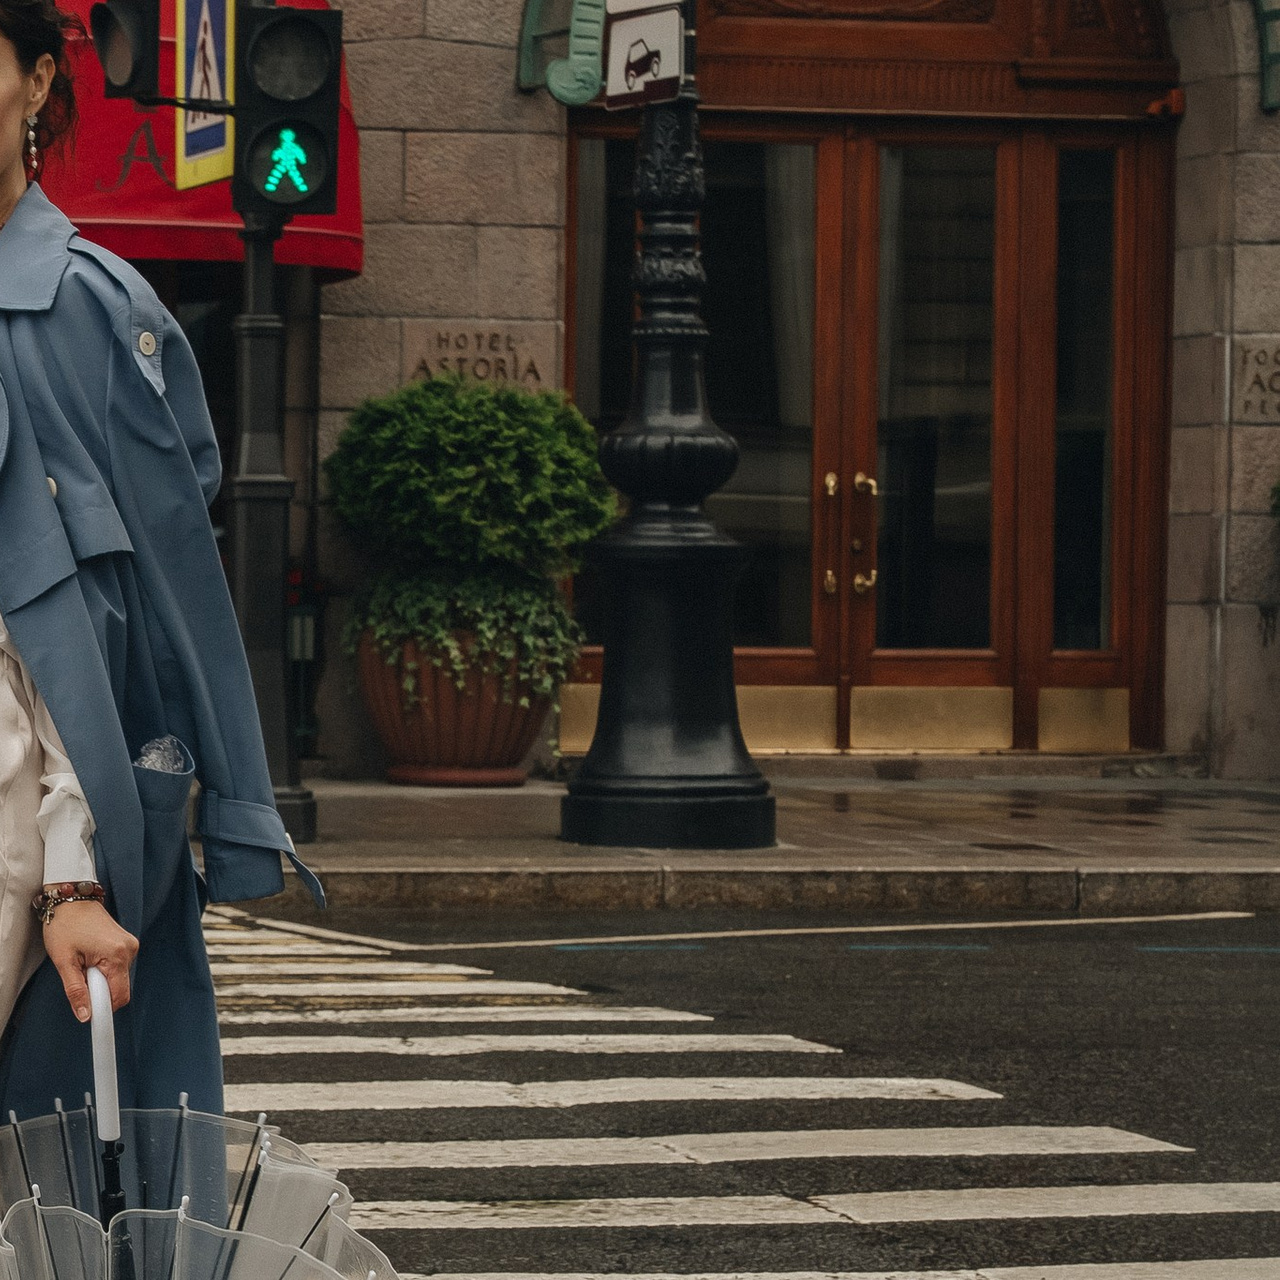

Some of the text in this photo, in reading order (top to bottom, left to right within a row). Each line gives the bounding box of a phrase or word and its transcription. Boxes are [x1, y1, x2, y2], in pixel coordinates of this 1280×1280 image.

[95, 119, 177, 193] A
[436, 331, 516, 352] HOTEL
[411, 354, 543, 382] ASTORIA
